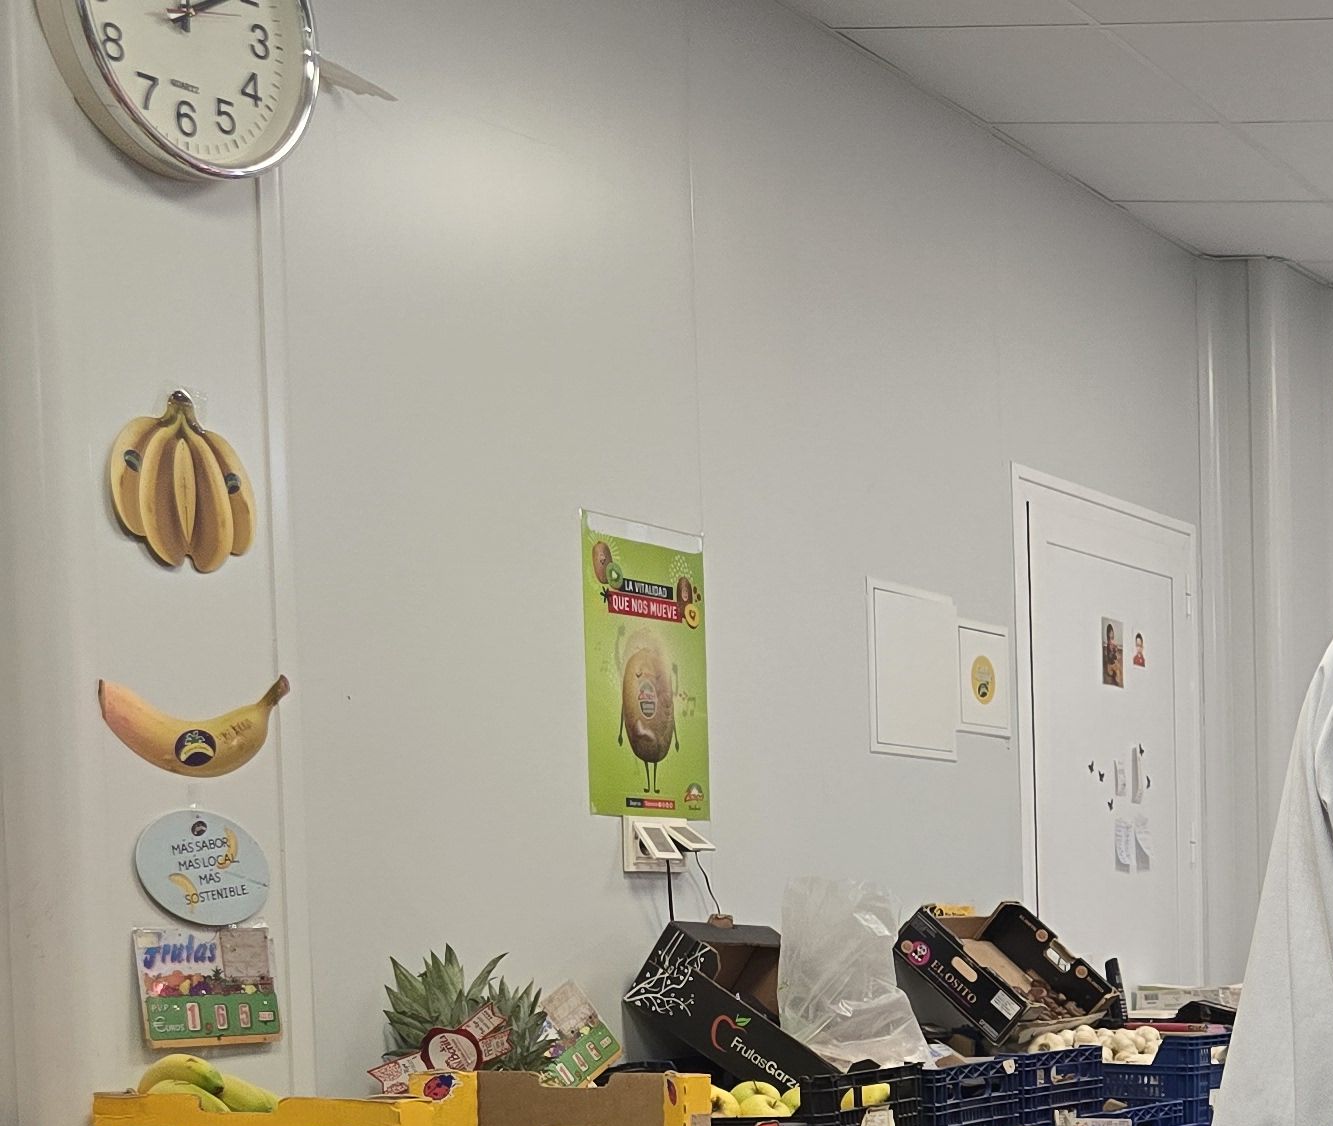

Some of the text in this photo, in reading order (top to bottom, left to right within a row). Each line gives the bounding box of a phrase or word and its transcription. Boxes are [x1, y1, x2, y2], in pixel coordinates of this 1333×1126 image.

[102, 22, 125, 63] 8
[249, 23, 271, 61] 3
[136, 70, 160, 110] 7
[240, 72, 263, 108] 4
[176, 99, 198, 138] 6
[215, 97, 238, 136] 5
[624, 580, 668, 598] LA VITALIDAD
[612, 595, 678, 620] QUE NOS MUEVE
[171, 837, 231, 856] MÁS SABOR
[201, 854, 239, 869] LOCAL
[199, 870, 222, 886] MÁS
[185, 885, 250, 906] SOSTENIBLE
[944, 973, 978, 1006] OSITO
